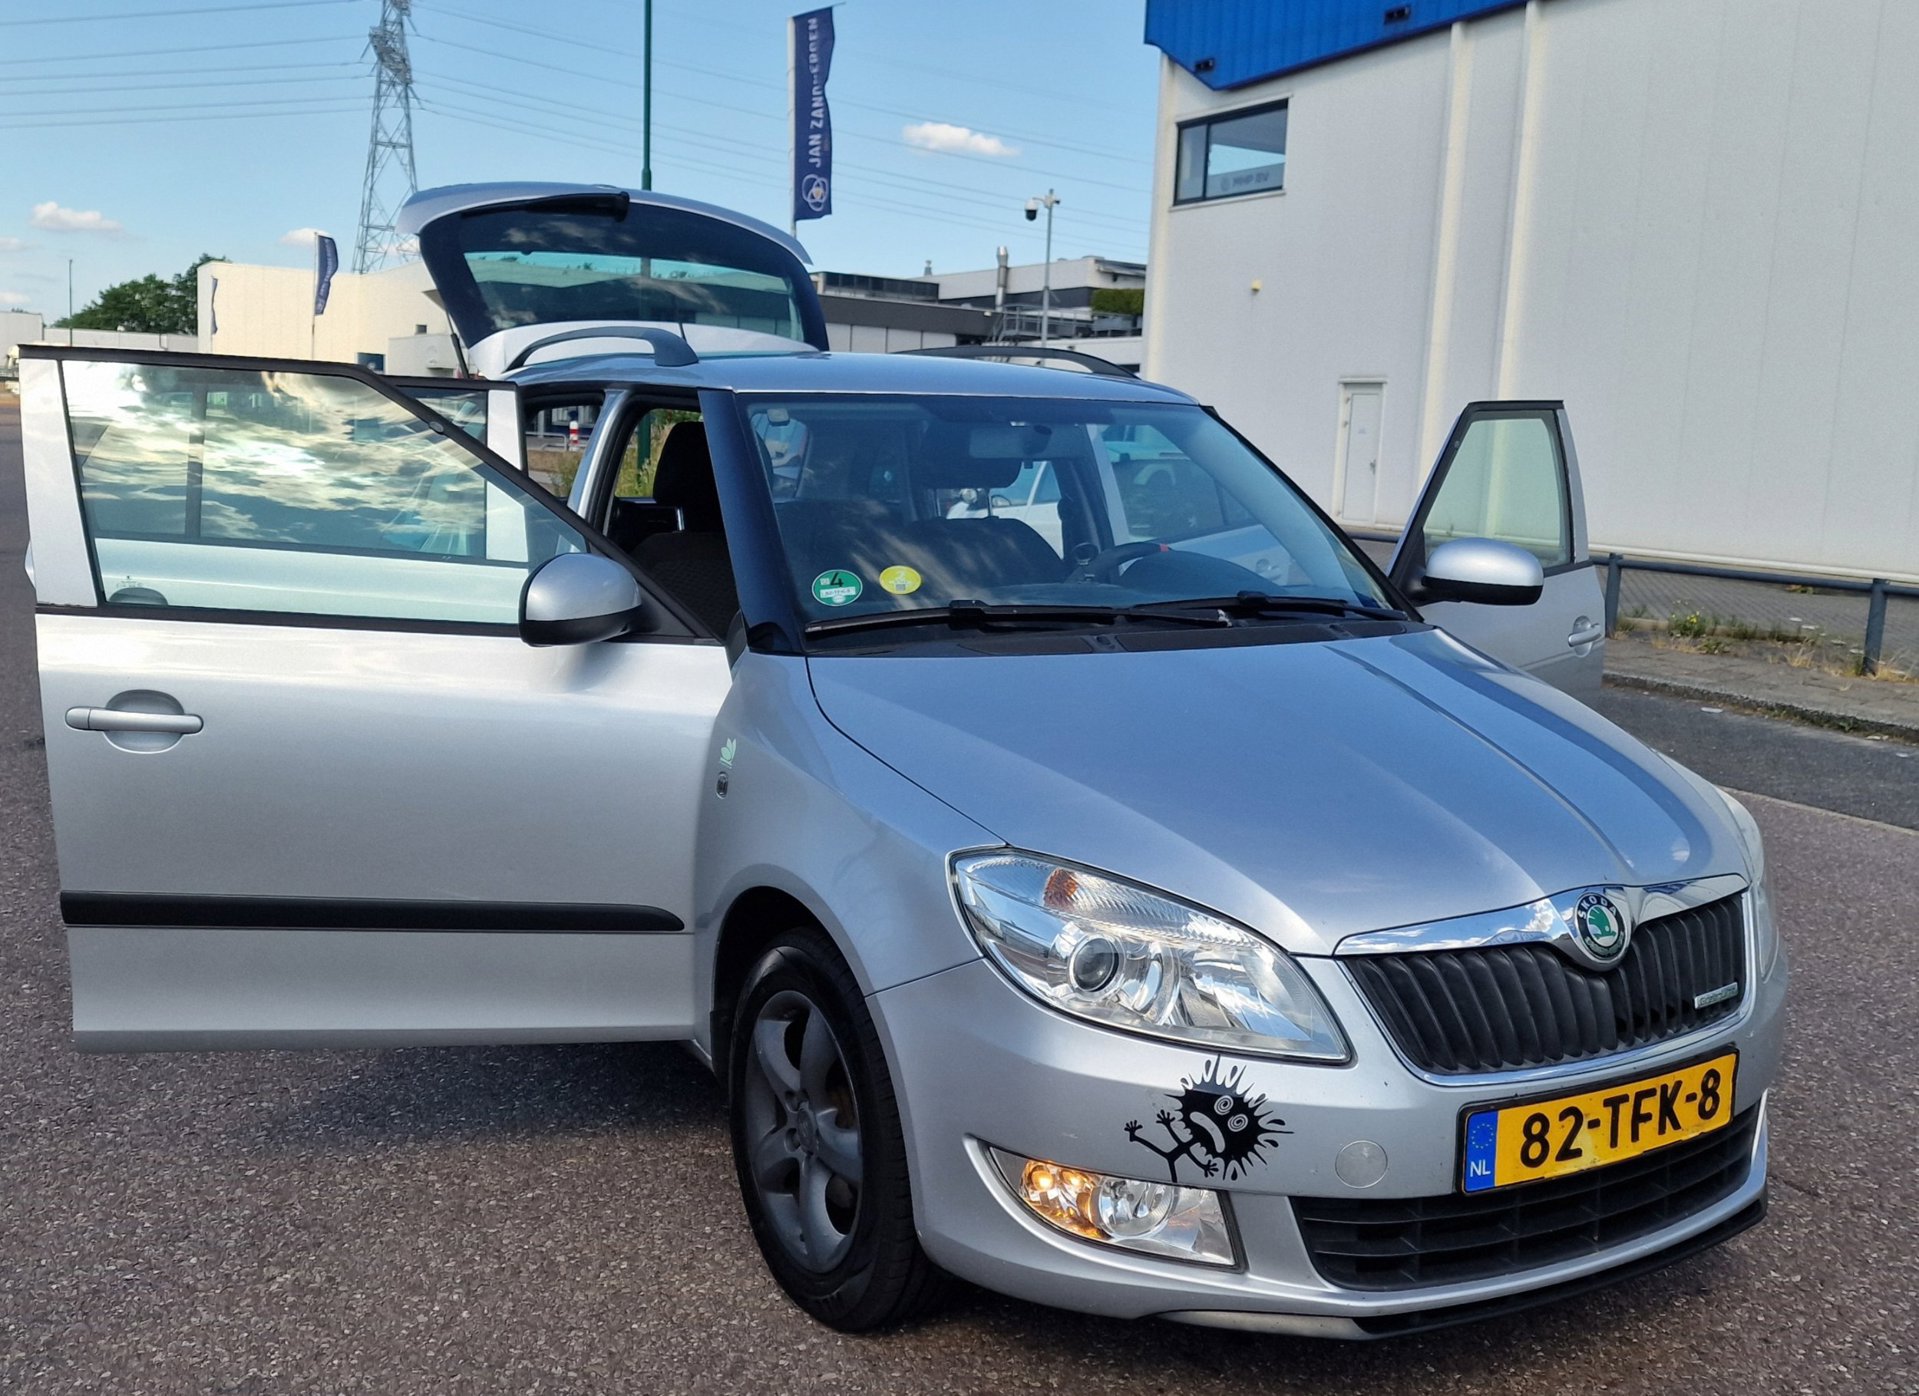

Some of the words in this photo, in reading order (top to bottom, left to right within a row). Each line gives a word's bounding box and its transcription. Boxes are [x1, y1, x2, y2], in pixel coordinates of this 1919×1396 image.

[808, 134, 822, 168] JAN
[830, 572, 844, 587] 4
[1520, 1068, 1721, 1168] 82-TFK-8
[1470, 1160, 1491, 1177] NL
